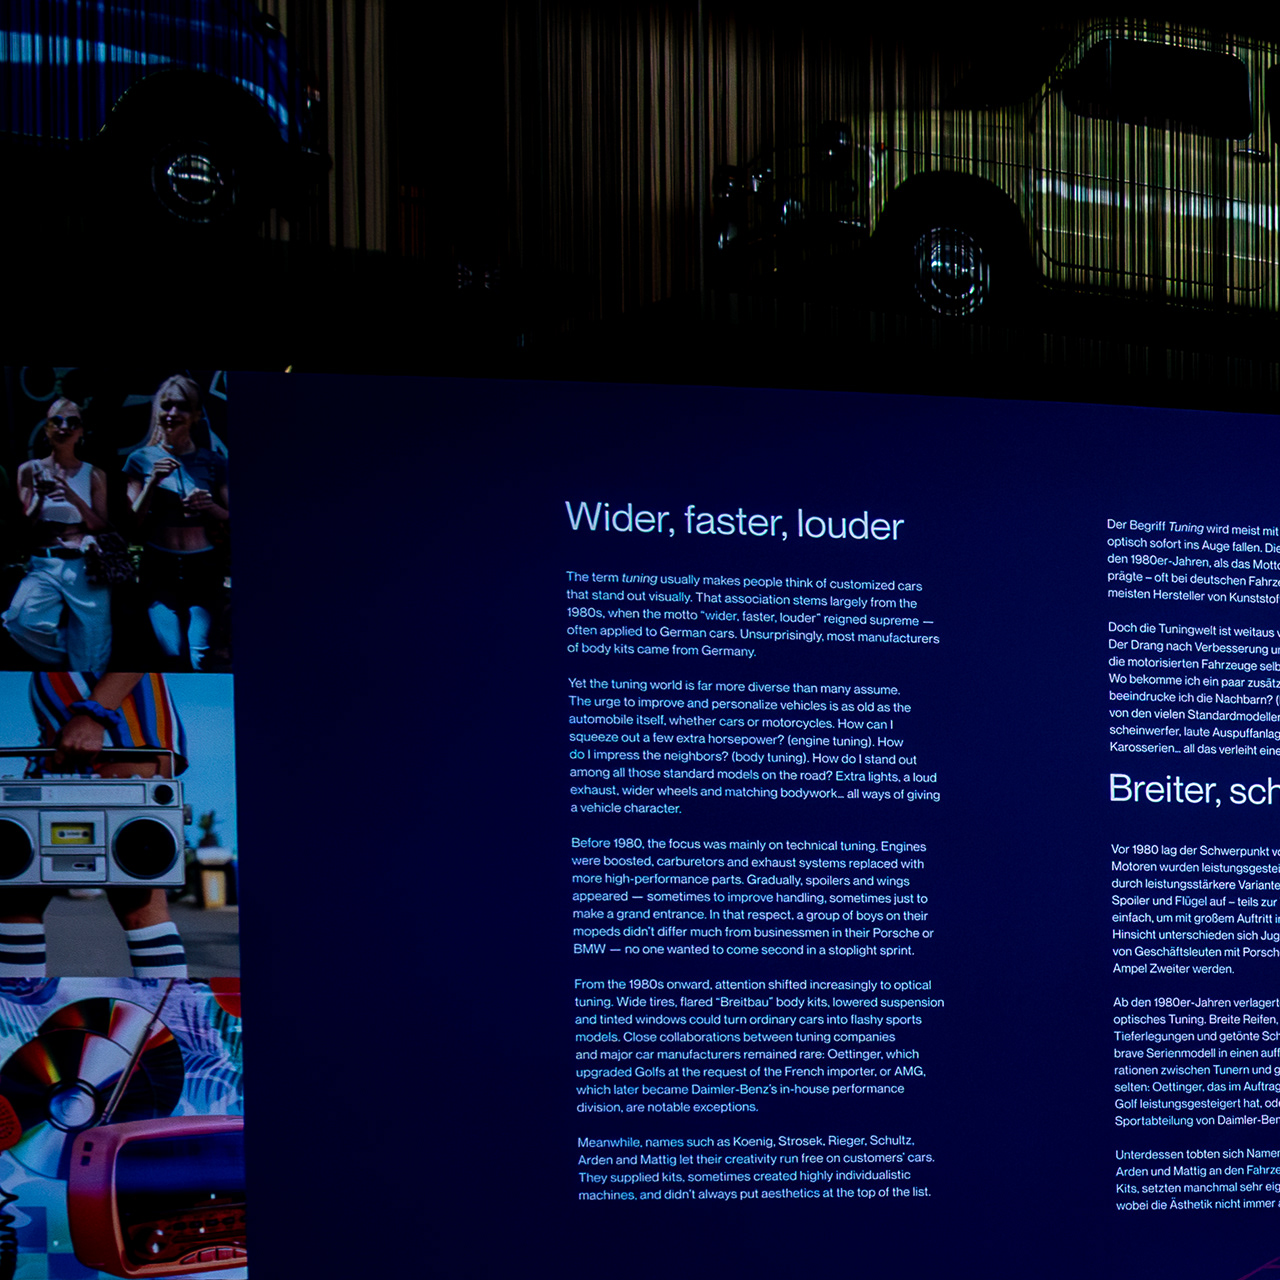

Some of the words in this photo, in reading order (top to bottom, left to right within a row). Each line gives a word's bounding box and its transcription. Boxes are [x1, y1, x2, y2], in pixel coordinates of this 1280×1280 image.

[565, 501, 674, 537] Wider,
[684, 505, 787, 541] faster,
[799, 509, 904, 540] louder
[565, 570, 590, 583] The
[591, 572, 620, 583] term
[621, 572, 659, 586] tuning
[660, 574, 701, 587] usually
[702, 575, 741, 587] makes
[743, 576, 783, 589] people
[785, 577, 814, 589] think
[815, 577, 828, 589] of
[829, 579, 896, 591] customized
[897, 582, 923, 592] cars
[566, 589, 589, 600] that
[591, 590, 625, 601] stand
[626, 591, 646, 601] out
[648, 591, 693, 605] visually.
[695, 591, 723, 604] That
[724, 593, 791, 606] association
[792, 595, 828, 607] stems
[829, 595, 868, 610] largely
[870, 596, 897, 608] from
[899, 598, 918, 609] the
[567, 606, 606, 619] 1980s,
[607, 607, 640, 619] when
[642, 608, 662, 620] the
[663, 609, 698, 621] motto
[742, 610, 778, 624] faster,
[823, 613, 867, 627] reigned
[869, 616, 920, 627] supreme
[566, 624, 598, 636] often
[599, 625, 643, 638] applied
[645, 626, 658, 637] to
[659, 625, 707, 639] German
[708, 629, 738, 639] cars.
[739, 628, 825, 643] Unsurprisingly,
[826, 631, 855, 642] most
[857, 631, 940, 645] manufacturers
[567, 642, 579, 653] of
[581, 642, 612, 656] body
[613, 643, 635, 655] kits
[636, 645, 670, 655] came
[671, 643, 699, 656] from
[701, 644, 757, 659] Germany.
[1110, 773, 1221, 807] Breiter,
[1115, 1149, 1184, 1161] Unterdessen
[1186, 1149, 1221, 1160] tobten
[1222, 1148, 1244, 1159] sich
[578, 1171, 608, 1185] They
[610, 1171, 660, 1185] supplied
[661, 1171, 686, 1183] kits,
[687, 1171, 752, 1183] sometimes
[753, 1170, 798, 1182] created
[799, 1170, 834, 1183] highly
[835, 1169, 912, 1181] individualistic
[1115, 1166, 1149, 1177] Arden
[1150, 1165, 1171, 1177] und
[1173, 1165, 1207, 1178] Mattig
[1208, 1167, 1223, 1176] an
[1223, 1165, 1245, 1176] den
[578, 1189, 638, 1201] machines,
[639, 1189, 662, 1201] and
[698, 1188, 738, 1202] always
[739, 1188, 759, 1201] put
[761, 1187, 821, 1199] aesthetics
[822, 1187, 834, 1198] at
[836, 1187, 855, 1198] the
[857, 1187, 876, 1200] top
[877, 1186, 890, 1198] of
[892, 1186, 911, 1197] the
[912, 1186, 931, 1197] list.
[1115, 1183, 1140, 1194] Kits,
[1141, 1183, 1182, 1194] setzten
[1183, 1181, 1238, 1193] manchmal
[1239, 1181, 1264, 1192] sehr
[1115, 1200, 1149, 1211] wobei
[1150, 1199, 1168, 1211] die
[1169, 1196, 1213, 1210] Ästhetik
[1214, 1198, 1241, 1209] nicht
[1243, 1198, 1276, 1209] immer
